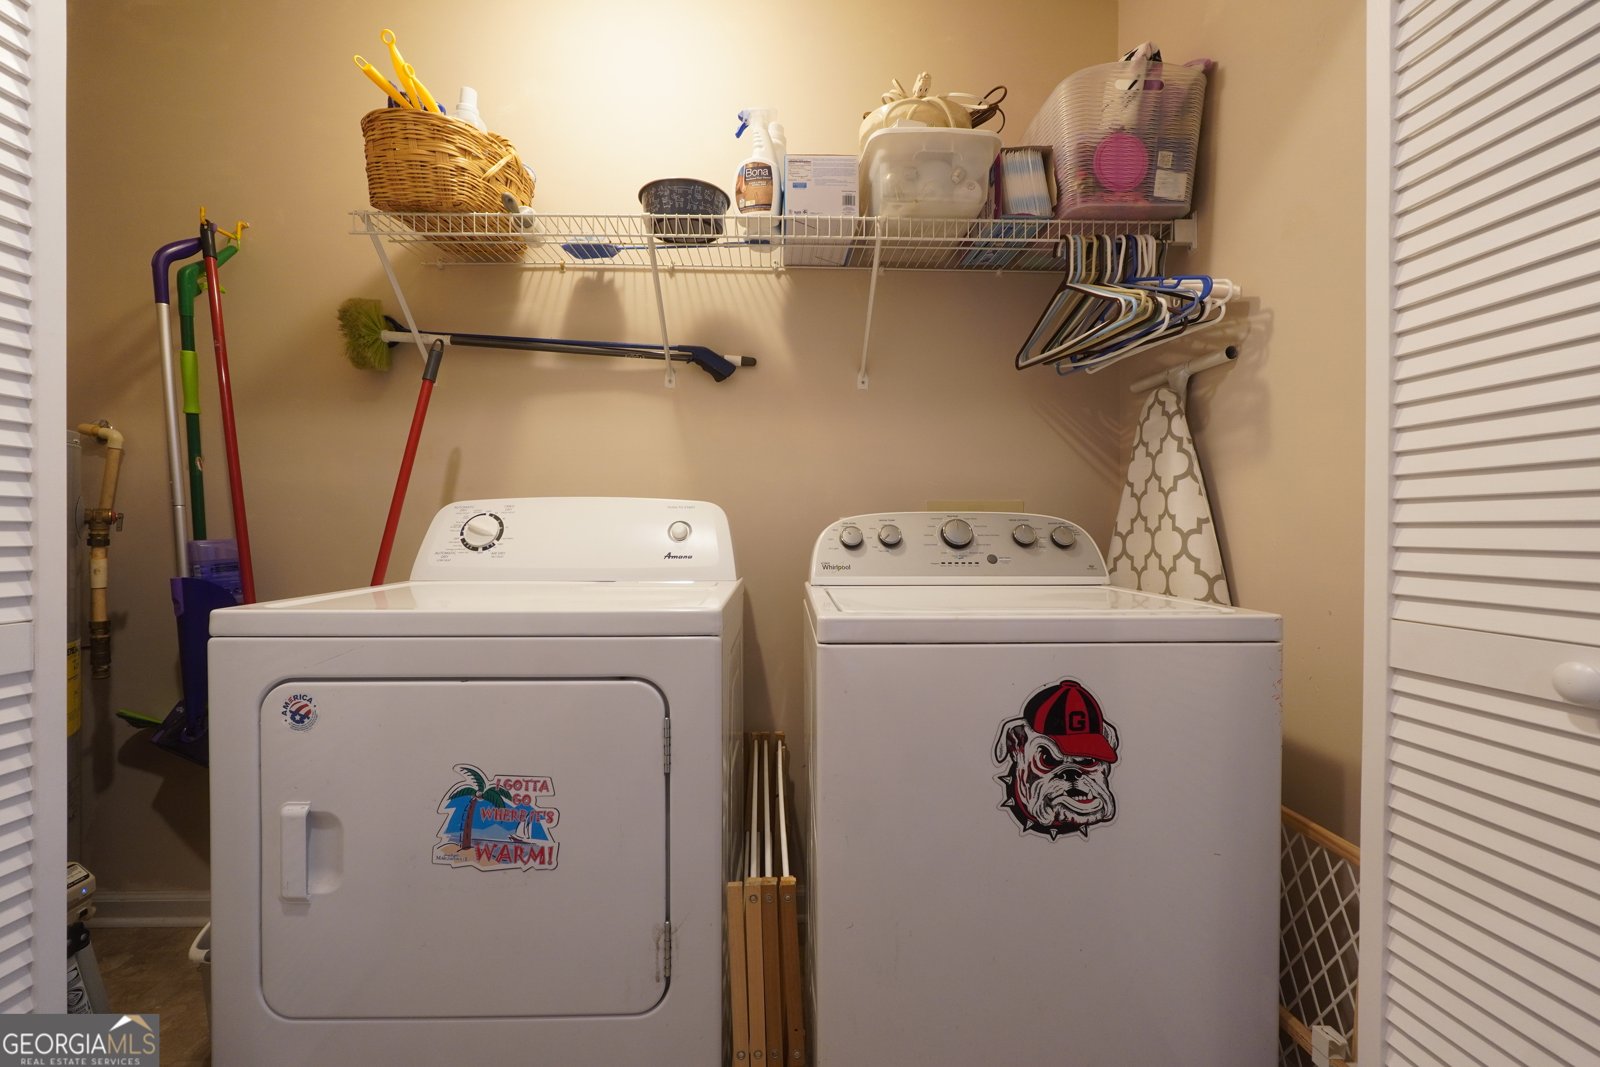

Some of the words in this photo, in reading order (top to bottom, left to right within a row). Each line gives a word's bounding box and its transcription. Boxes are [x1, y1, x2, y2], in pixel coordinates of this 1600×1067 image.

[745, 168, 769, 177] Bona
[663, 551, 693, 560] Amana
[281, 694, 313, 716] AMERICA
[1069, 711, 1086, 731] G
[495, 778, 502, 790] I
[503, 778, 550, 792] GOTTA
[512, 793, 532, 806] GO
[481, 807, 526, 822] WHERE
[529, 810, 555, 824] IT'S
[475, 843, 554, 866] WARM!
